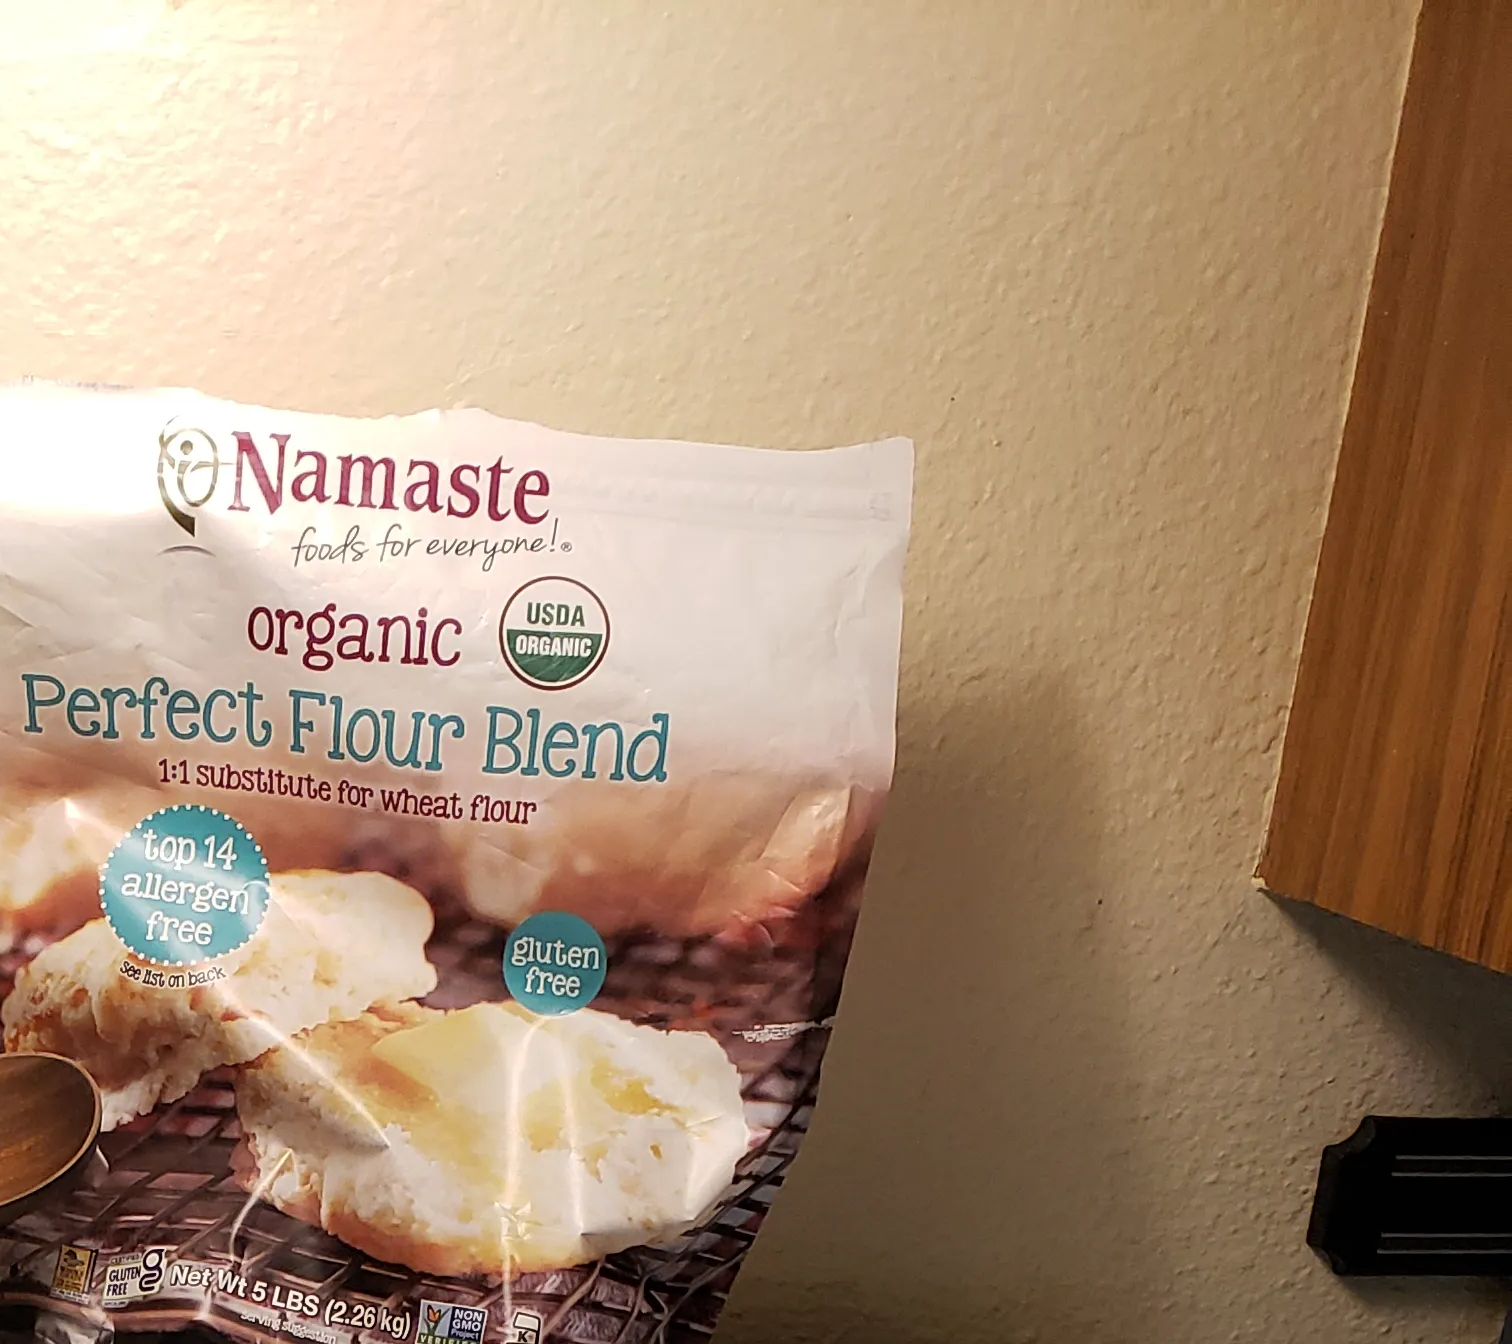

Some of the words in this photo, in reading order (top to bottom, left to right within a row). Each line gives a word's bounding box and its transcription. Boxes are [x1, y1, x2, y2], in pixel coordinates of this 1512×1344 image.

[227, 430, 550, 526] Namaste
[291, 524, 369, 567] foods
[377, 524, 421, 562] for
[526, 602, 586, 627] USDA
[248, 603, 463, 672] organic
[515, 634, 592, 657] ORGANIC
[22, 674, 272, 746] Perfect
[289, 688, 466, 775] Flour
[483, 706, 671, 783] Blend
[157, 758, 191, 786] 1:1
[195, 761, 332, 803] substitute
[337, 781, 374, 809] for
[380, 788, 463, 821] wheat
[468, 795, 537, 826] flour
[143, 828, 197, 871] top
[203, 836, 238, 870] 14
[121, 873, 251, 916] allergen
[145, 912, 214, 947] free
[510, 936, 601, 971] gluten
[119, 959, 145, 983] see
[167, 973, 186, 989] on
[187, 964, 227, 987] back
[524, 968, 582, 999] free
[106, 1282, 128, 1296] FREE
[109, 1266, 141, 1282] GLUTEN
[171, 1265, 211, 1286] Net
[217, 1269, 247, 1297] Wt
[252, 1281, 268, 1302] 5
[272, 1285, 320, 1316] LBS
[324, 1299, 376, 1328] (2.26
[381, 1308, 411, 1340] kg)
[454, 1309, 483, 1322] NON
[451, 1328, 479, 1340] Project
[452, 1320, 482, 1332] GMO
